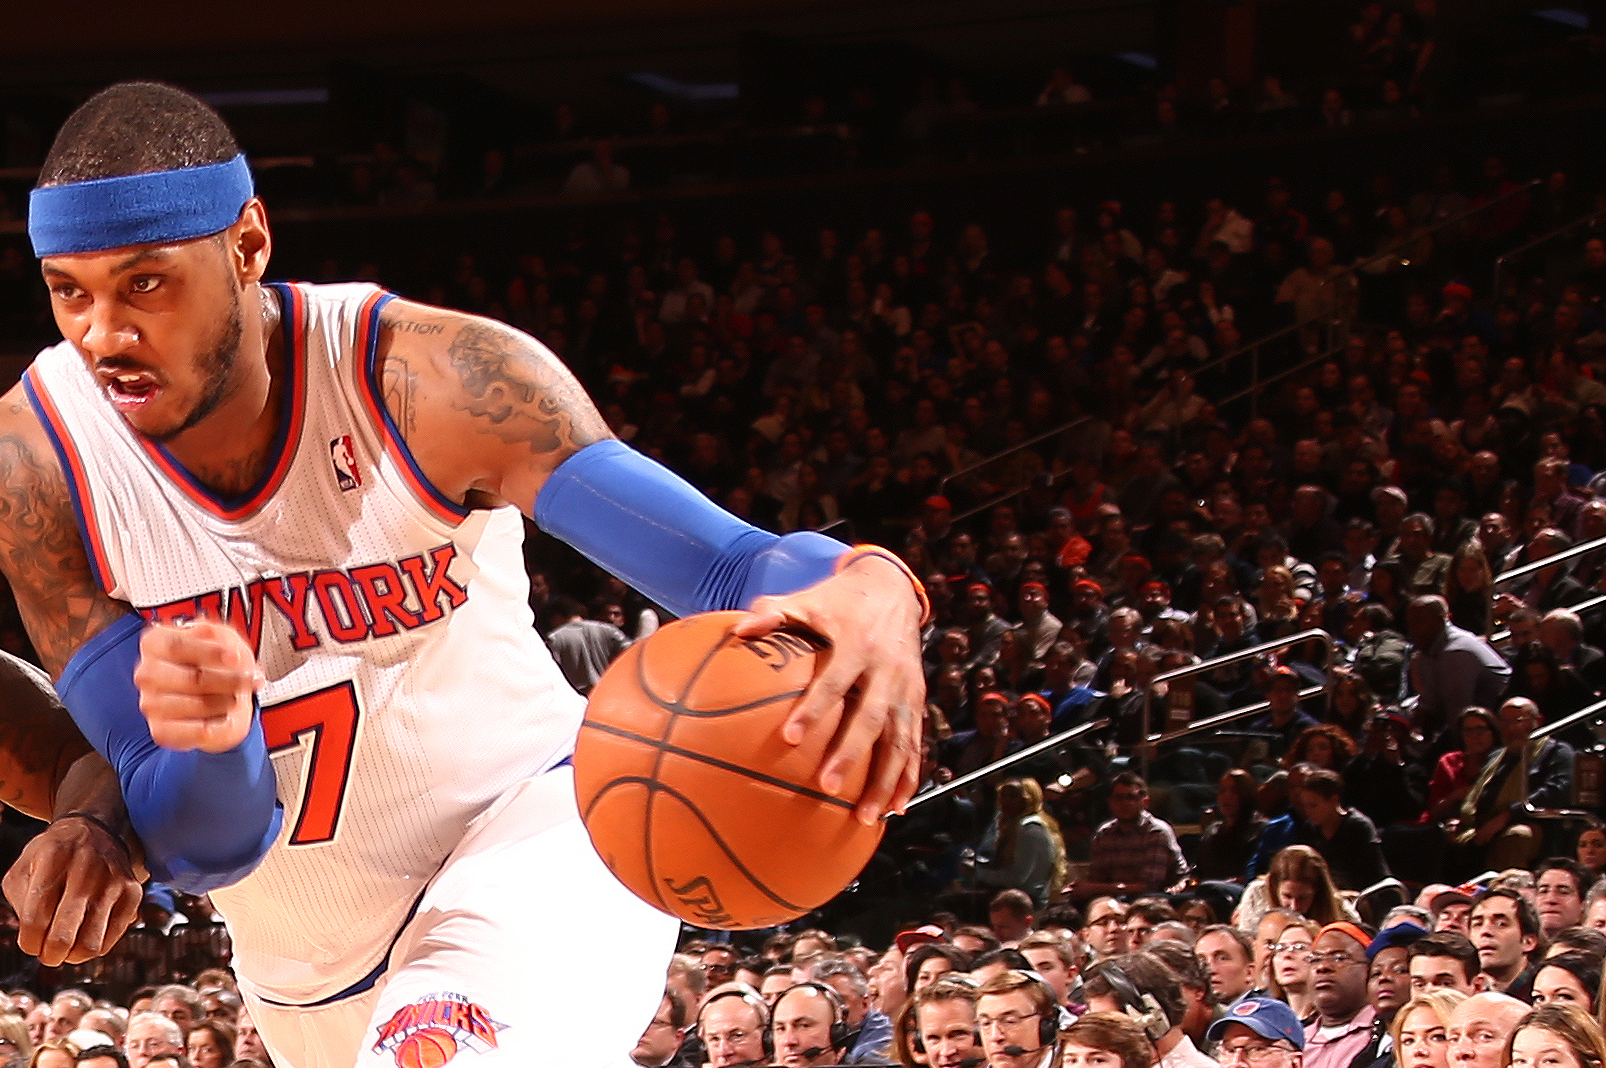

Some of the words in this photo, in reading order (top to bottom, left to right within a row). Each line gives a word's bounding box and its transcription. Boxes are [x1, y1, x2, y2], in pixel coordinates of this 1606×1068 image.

[262, 540, 469, 652] YORK
[259, 679, 362, 847] 7
[373, 999, 499, 1049] KNICKS
